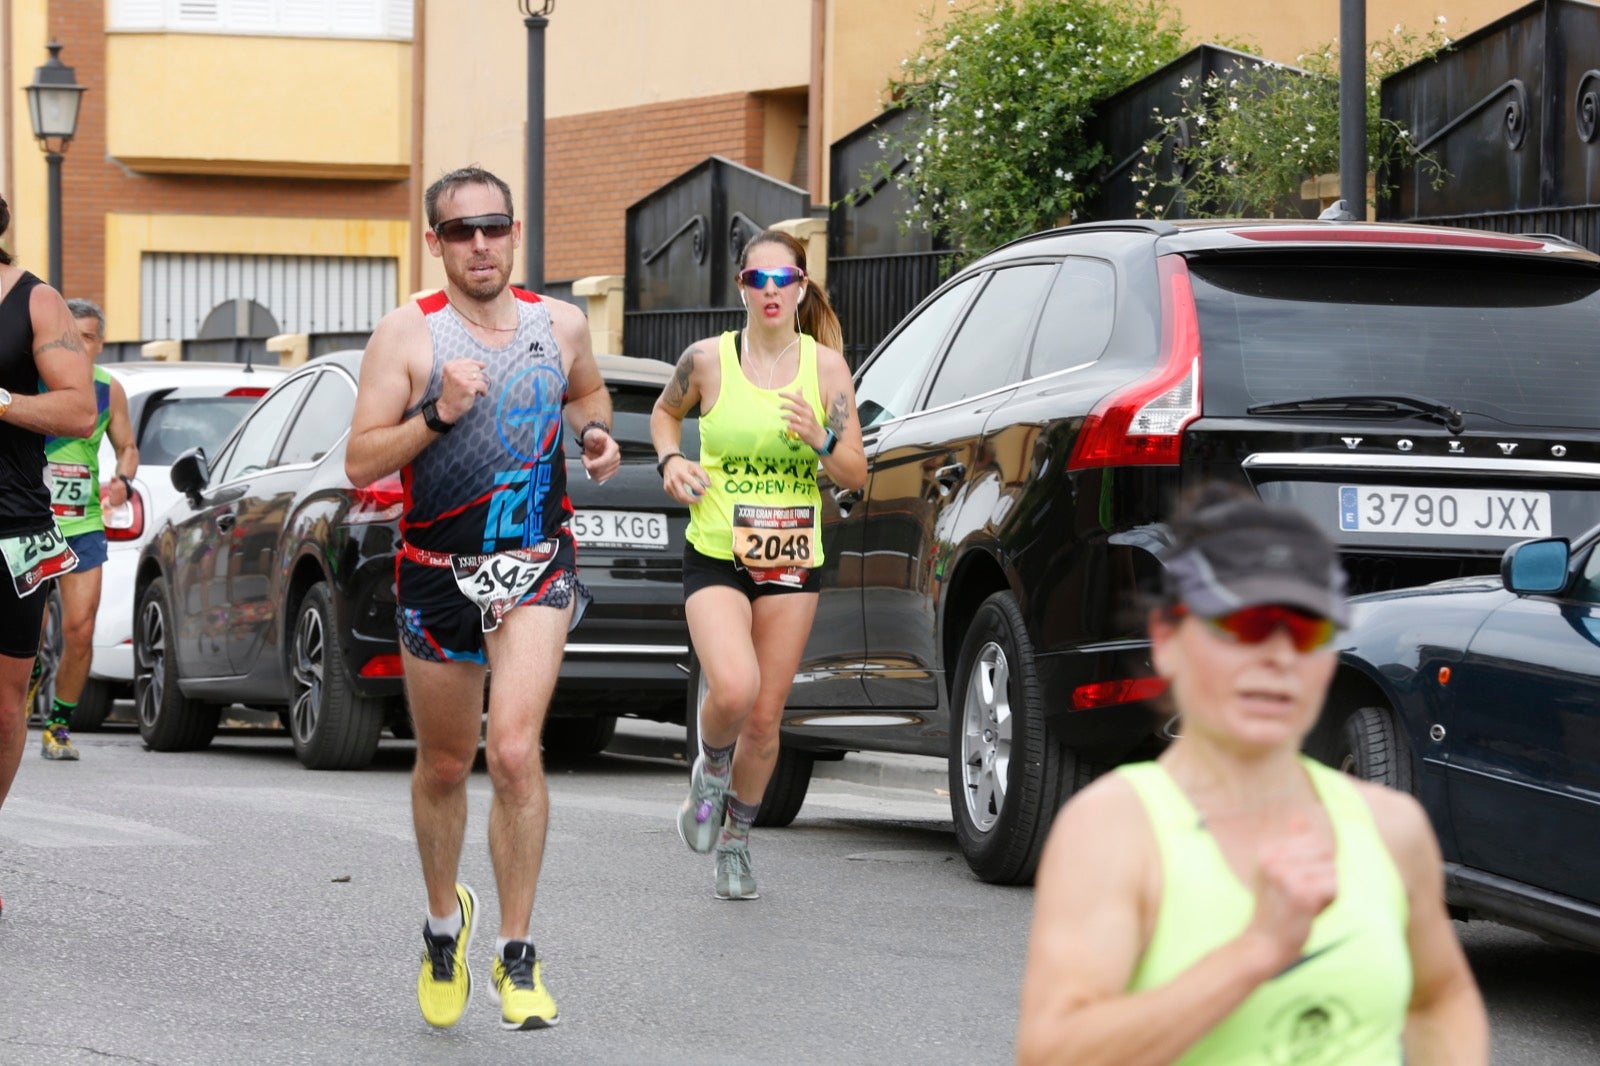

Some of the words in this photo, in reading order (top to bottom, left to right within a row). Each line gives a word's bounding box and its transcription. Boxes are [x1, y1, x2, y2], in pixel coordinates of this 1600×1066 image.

[1341, 437, 1567, 457] VOLVO
[56, 480, 82, 501] 75
[1366, 492, 1458, 527] 3790
[1474, 496, 1540, 531] JXX
[614, 515, 661, 539] KGG
[745, 534, 810, 560] 2048
